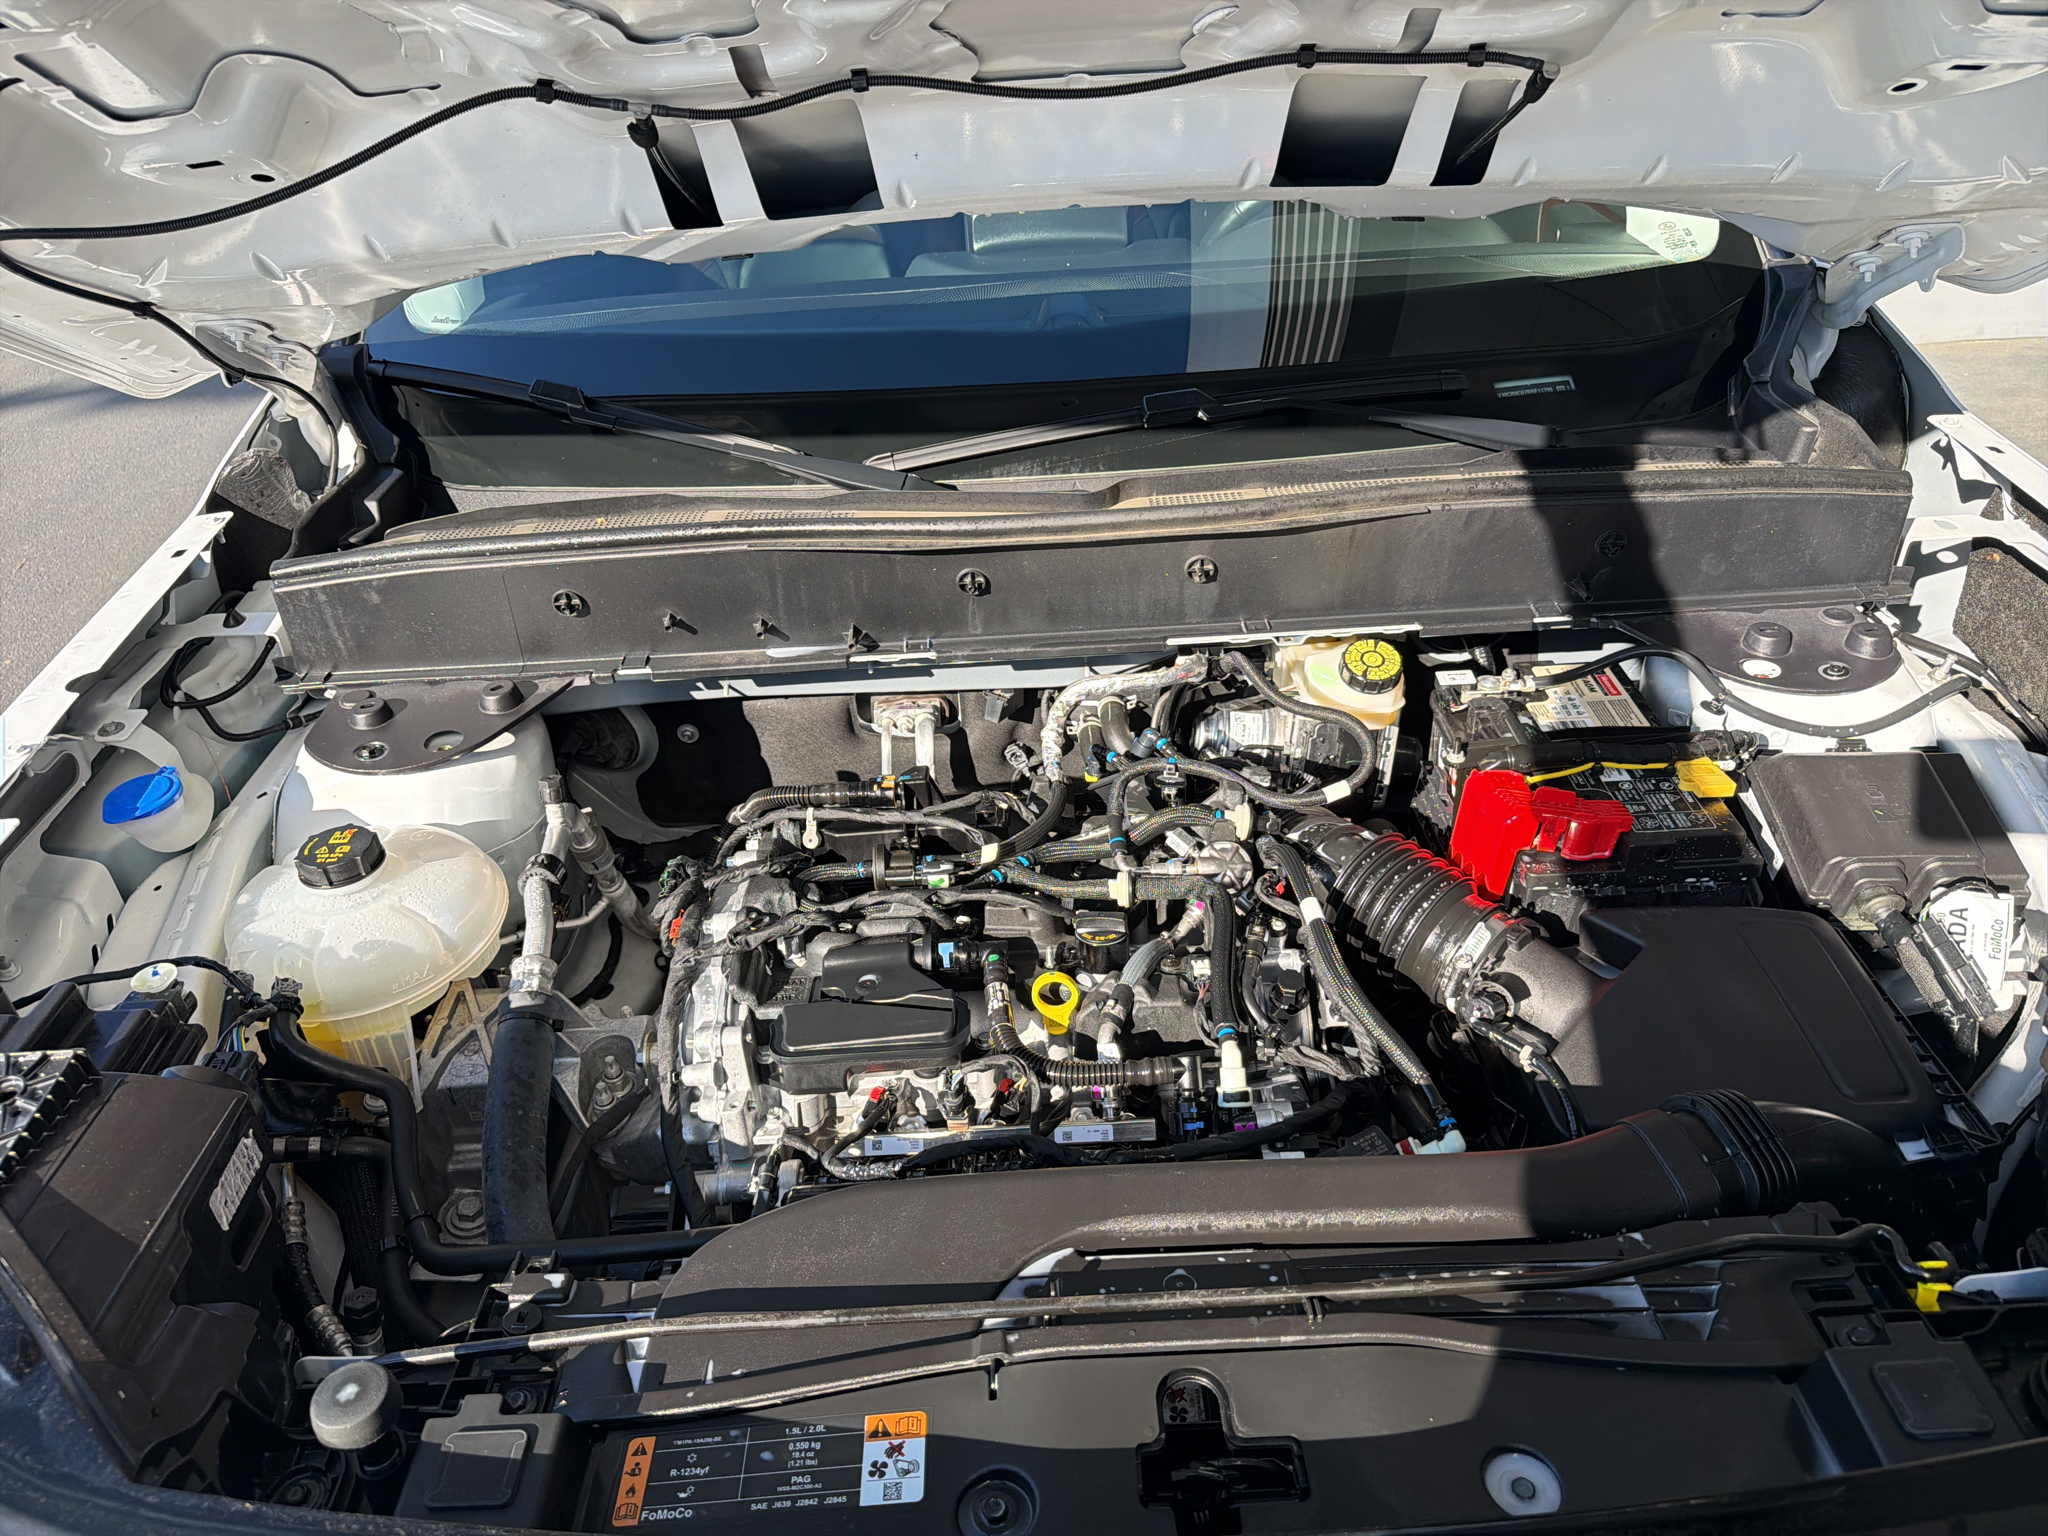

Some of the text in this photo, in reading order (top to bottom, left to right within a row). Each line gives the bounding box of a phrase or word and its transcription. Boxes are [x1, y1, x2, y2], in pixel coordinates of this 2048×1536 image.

[1988, 918, 2004, 960] FoMoCo
[785, 1427, 802, 1435] 1.5L
[809, 1424, 826, 1433] 2.0L
[788, 1441, 821, 1450] 0.550 kg
[670, 1465, 710, 1477] R-1234yf
[791, 1475, 811, 1484] PAG
[750, 1496, 847, 1510] SAE J639 J2842 J2845
[641, 1507, 693, 1521] FoMoCo
